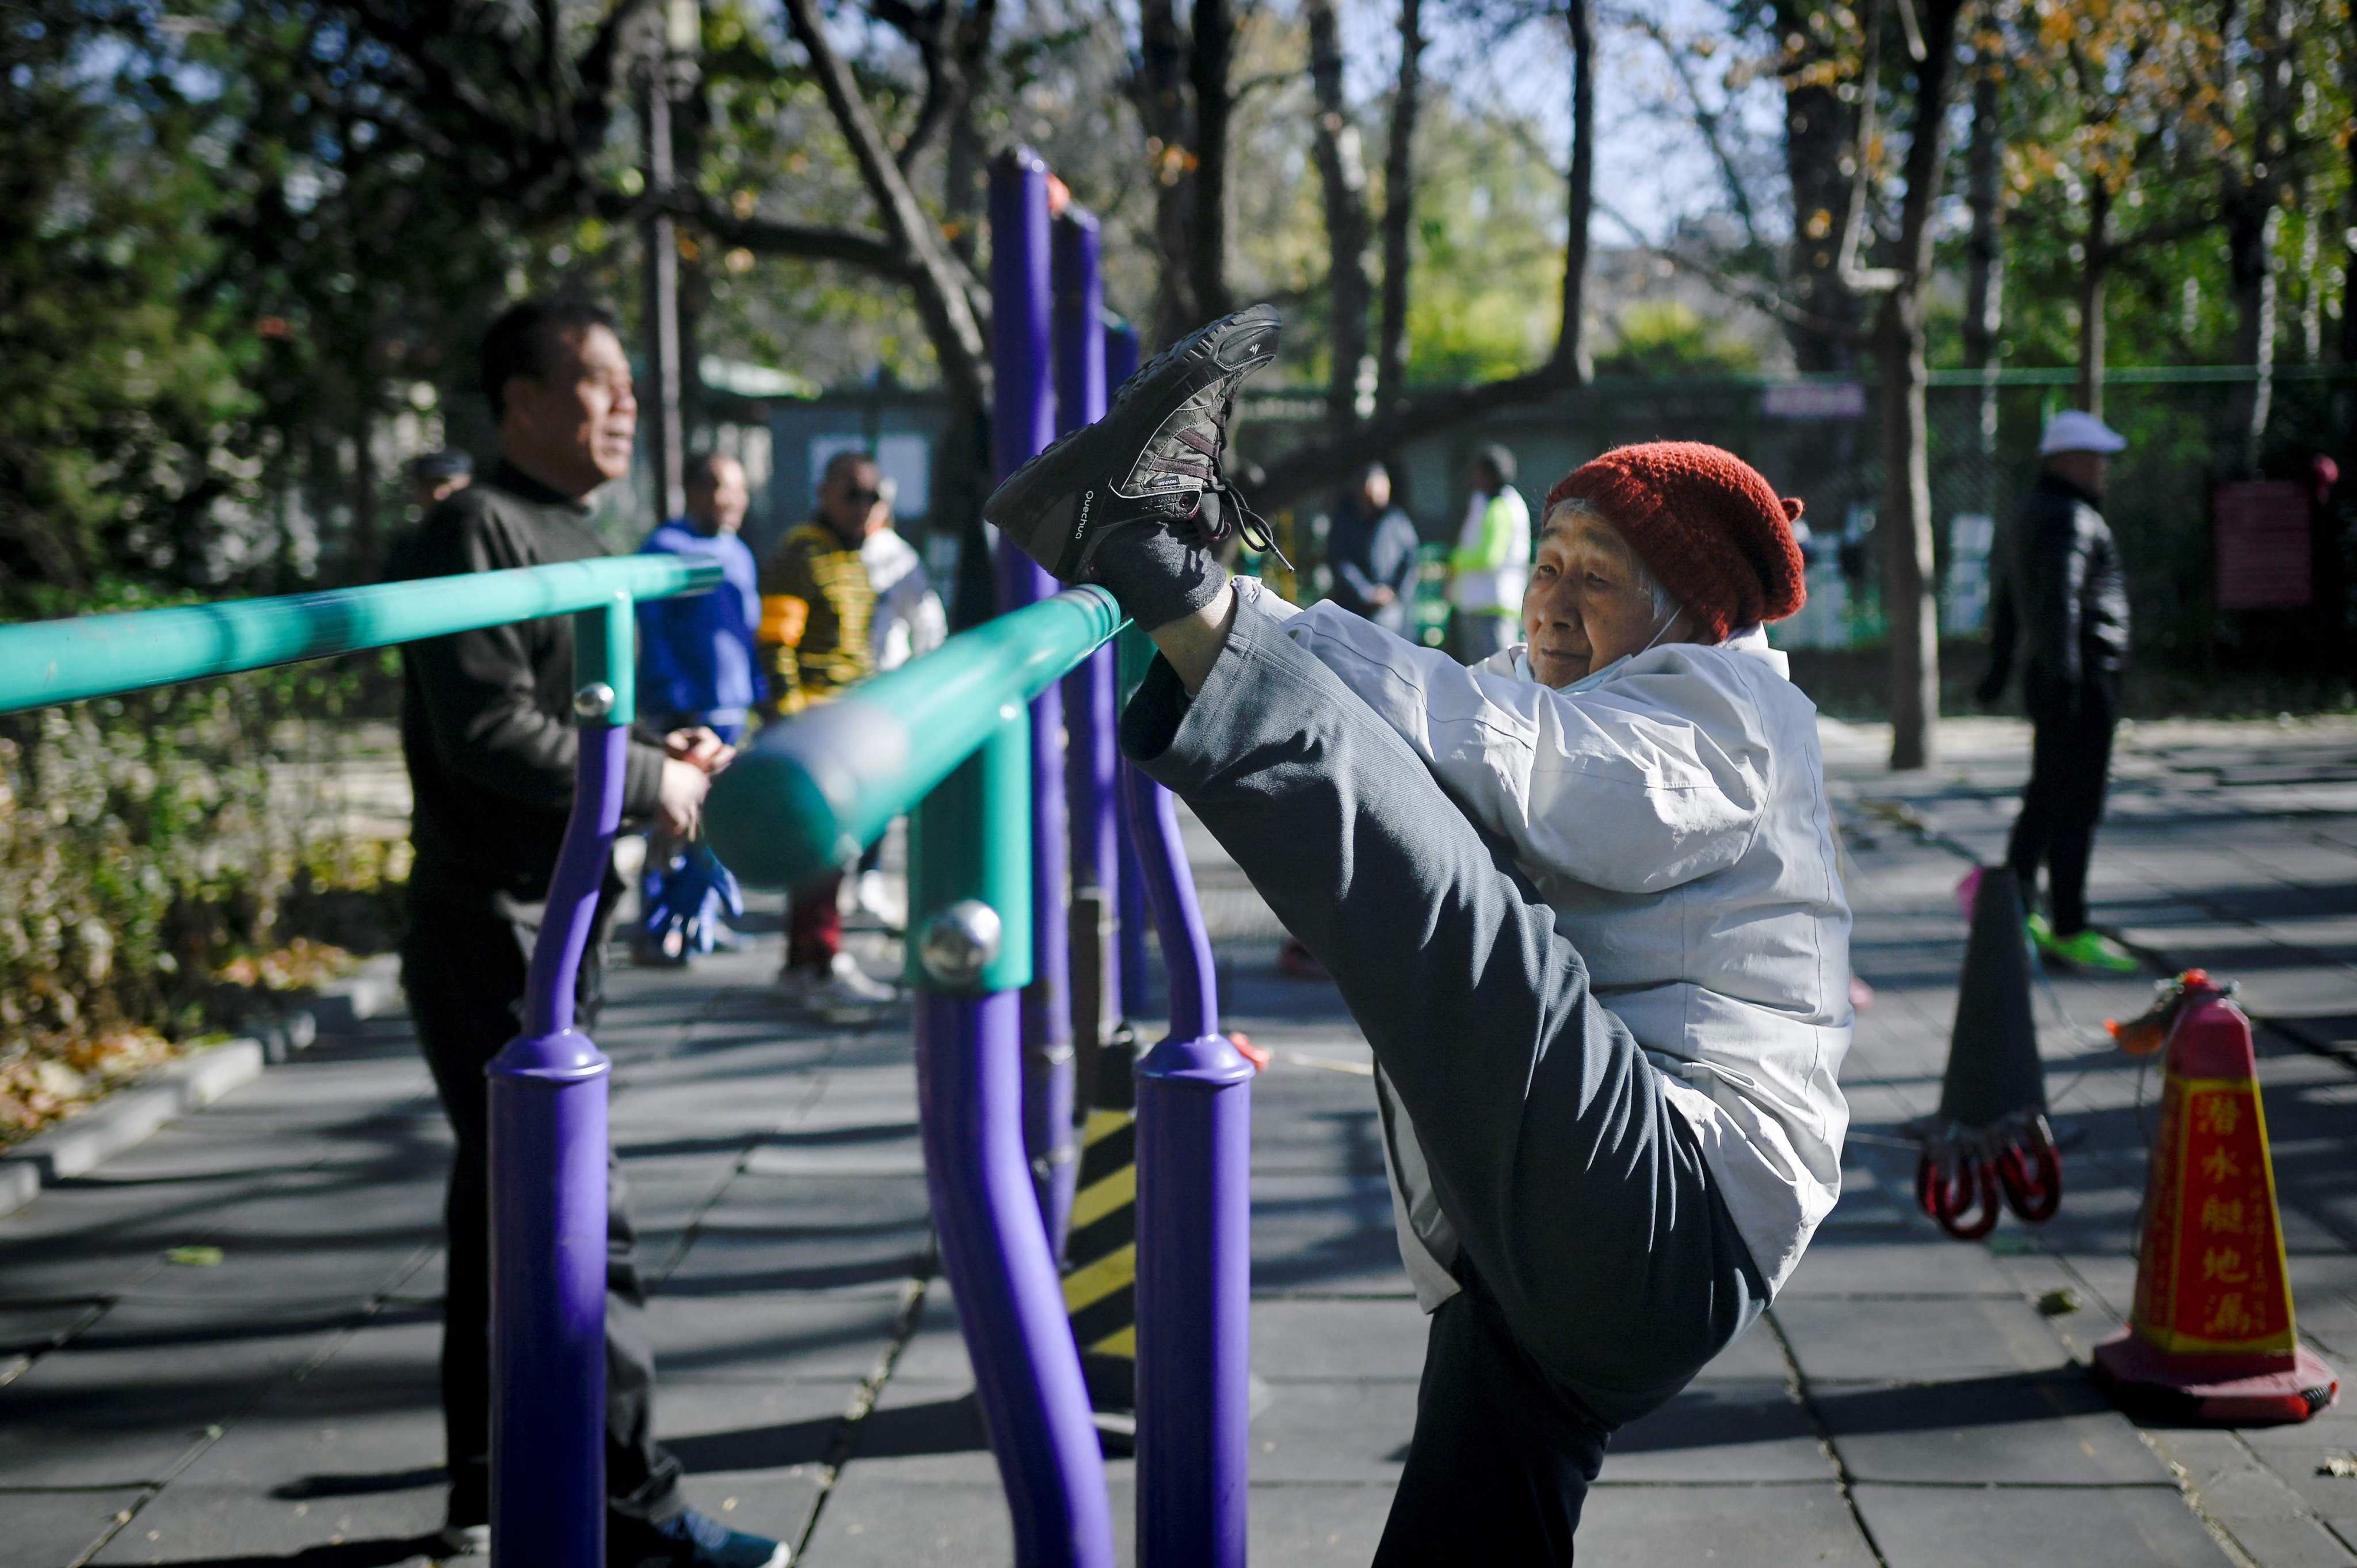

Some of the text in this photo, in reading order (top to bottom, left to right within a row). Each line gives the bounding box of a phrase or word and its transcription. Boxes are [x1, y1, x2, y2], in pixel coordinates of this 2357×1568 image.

[1075, 490, 1094, 539] Quechua
[2194, 1094, 2251, 1335] 潜水艇地漏
